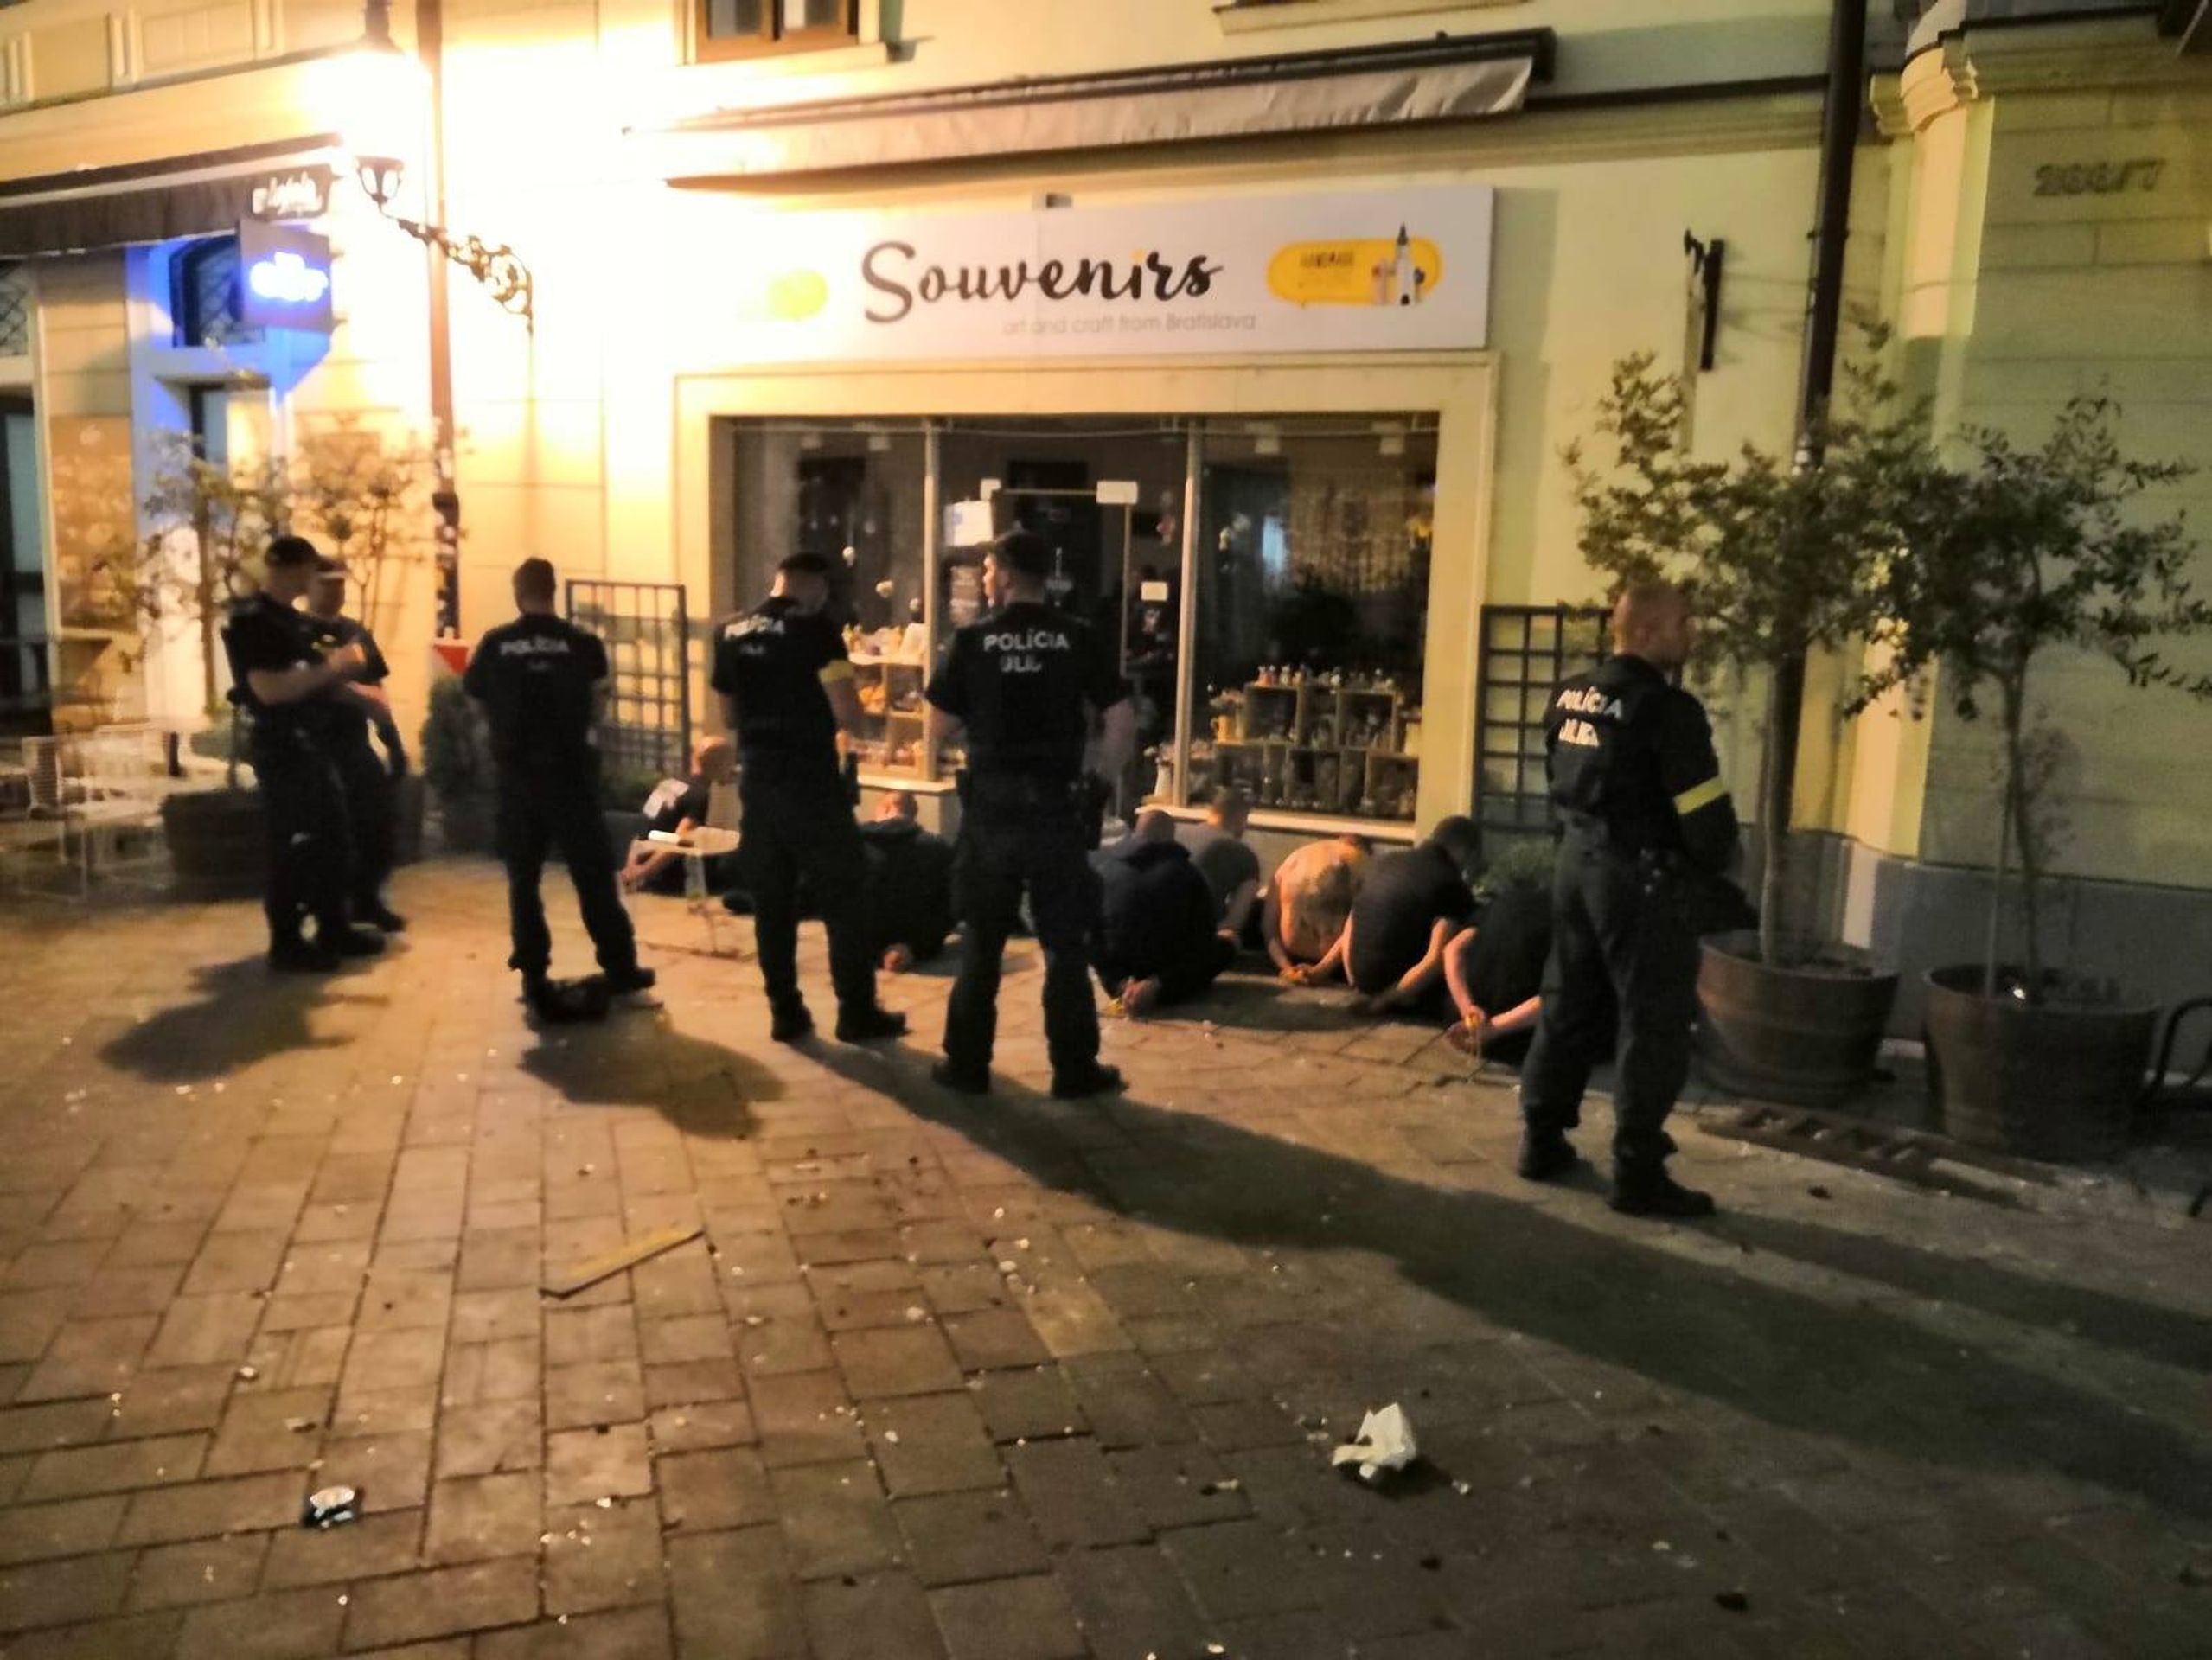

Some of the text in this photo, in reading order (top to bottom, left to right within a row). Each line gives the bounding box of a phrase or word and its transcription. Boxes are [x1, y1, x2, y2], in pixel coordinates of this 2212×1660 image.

[861, 241, 1224, 324] Souvenirs
[1119, 314, 1160, 332] from
[1167, 312, 1256, 331] Bratislava
